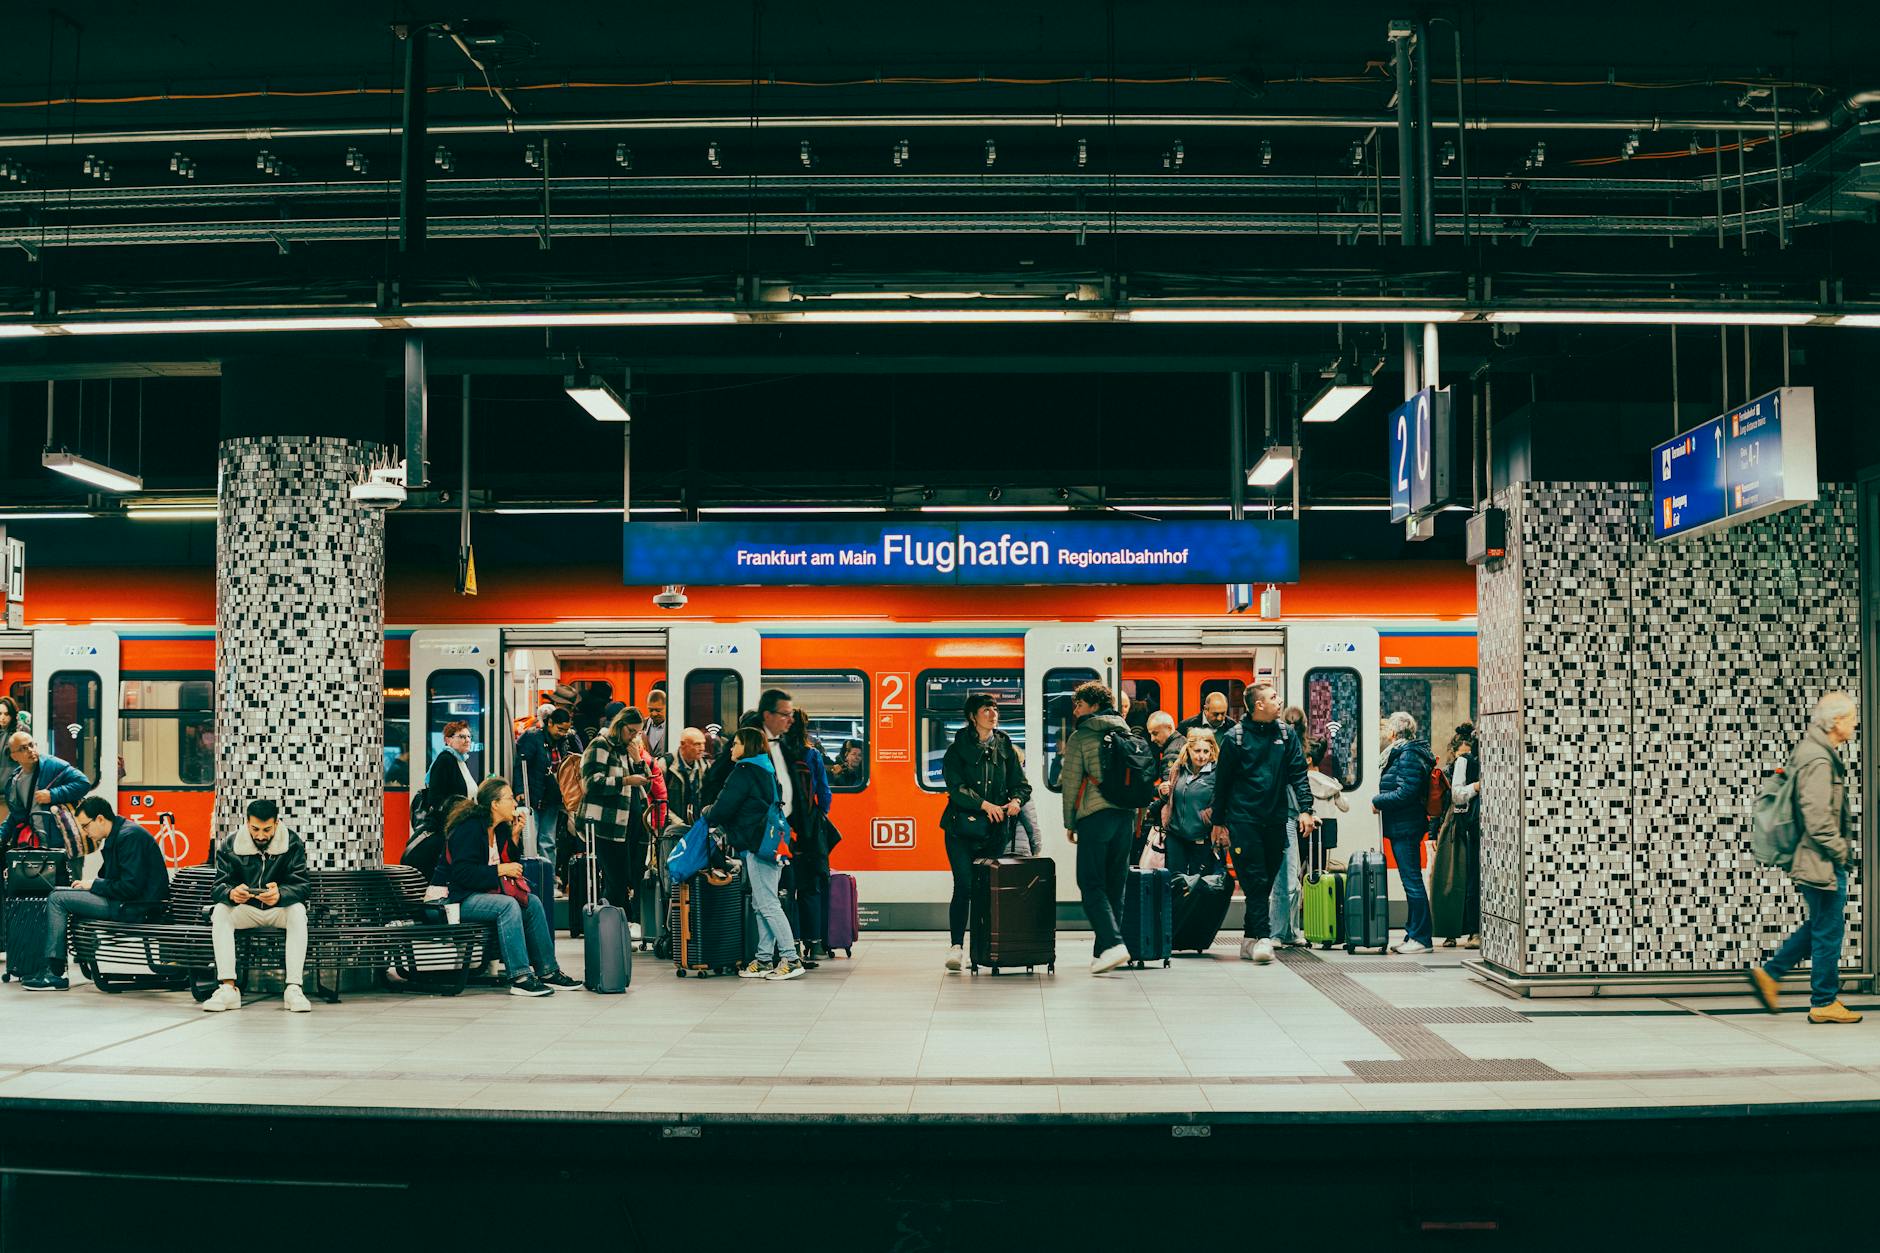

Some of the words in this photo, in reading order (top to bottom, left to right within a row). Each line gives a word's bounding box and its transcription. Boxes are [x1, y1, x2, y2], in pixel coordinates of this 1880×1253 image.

[1397, 415, 1408, 492] 2
[1416, 395, 1428, 481] C
[737, 550, 807, 566] Frankfurt
[810, 553, 834, 566] am
[839, 550, 877, 566] Main
[883, 534, 1049, 573] Flughafen
[1058, 549, 1189, 568] Regionalbahnhof
[881, 675, 903, 710] 2
[876, 823, 911, 844] DB
